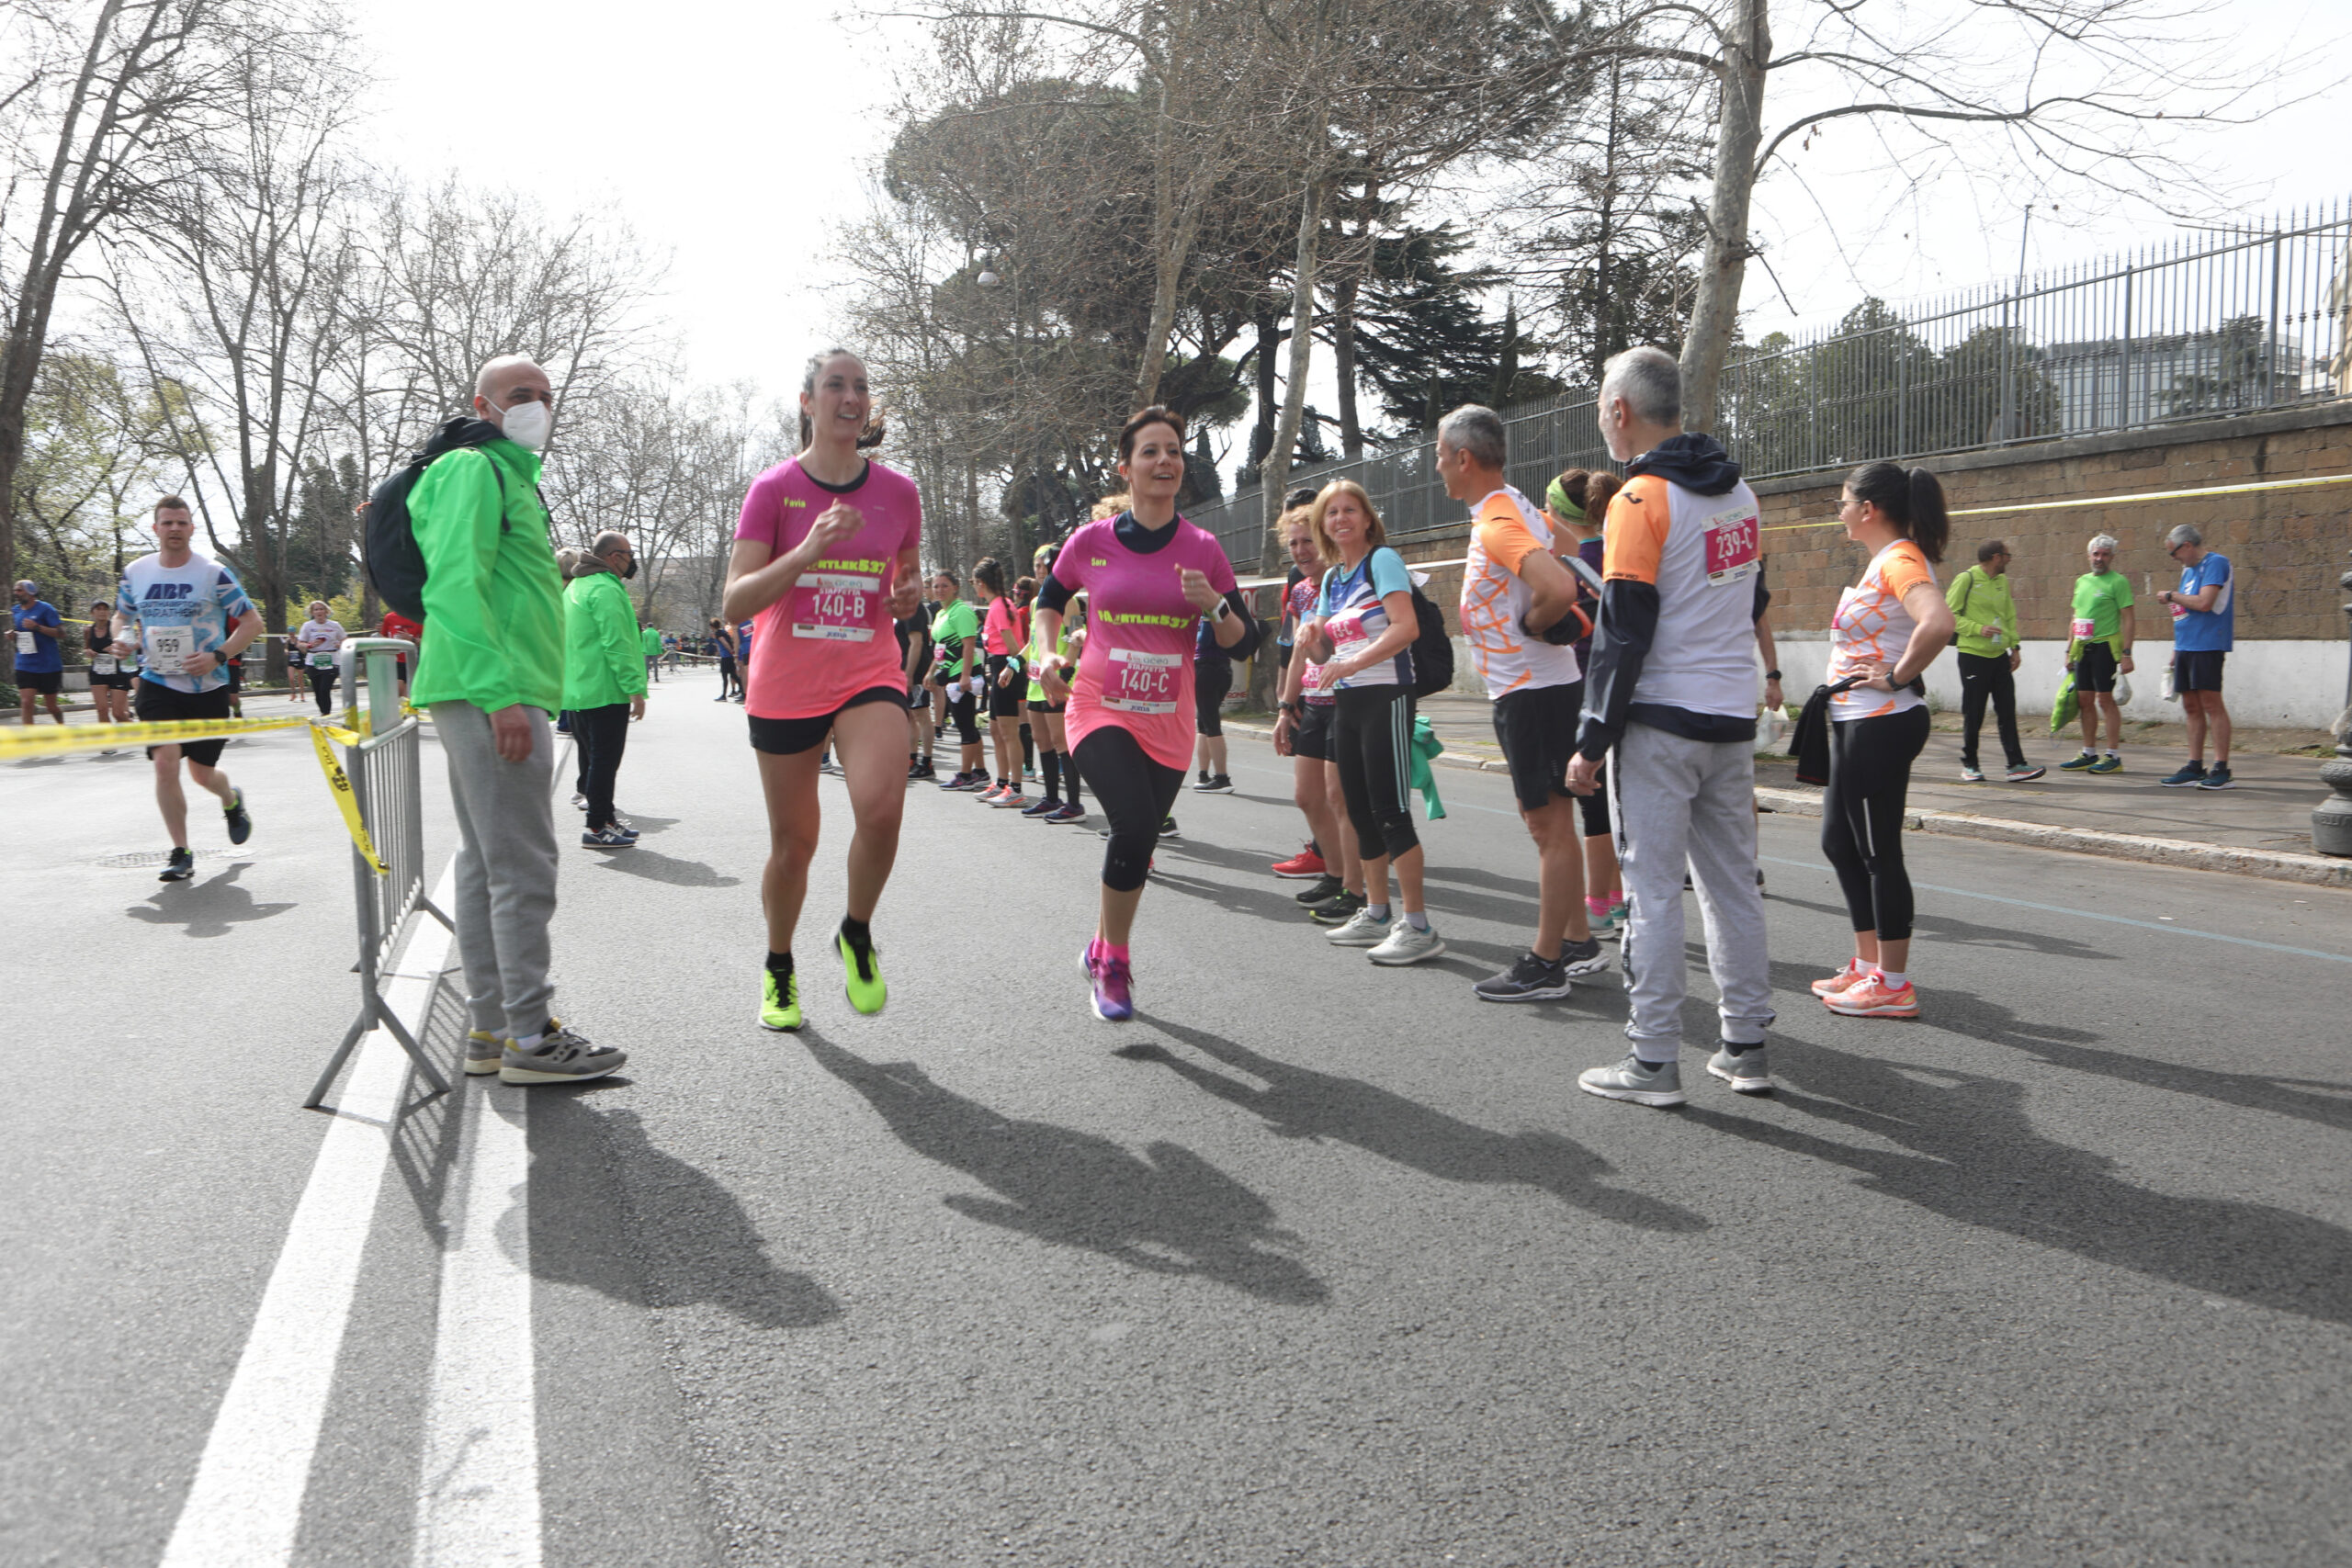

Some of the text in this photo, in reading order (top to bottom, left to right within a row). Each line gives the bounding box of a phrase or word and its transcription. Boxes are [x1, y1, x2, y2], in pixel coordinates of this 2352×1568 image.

[1716, 526, 1754, 559] 239-C
[1091, 558, 1107, 567] Sara
[145, 583, 193, 600] ABP
[819, 588, 861, 596] STAFFETTA
[812, 594, 866, 618] 140-B
[156, 638, 180, 653] 959
[1127, 662, 1167, 672] STAFFETTA
[1121, 669, 1170, 694] 140-C
